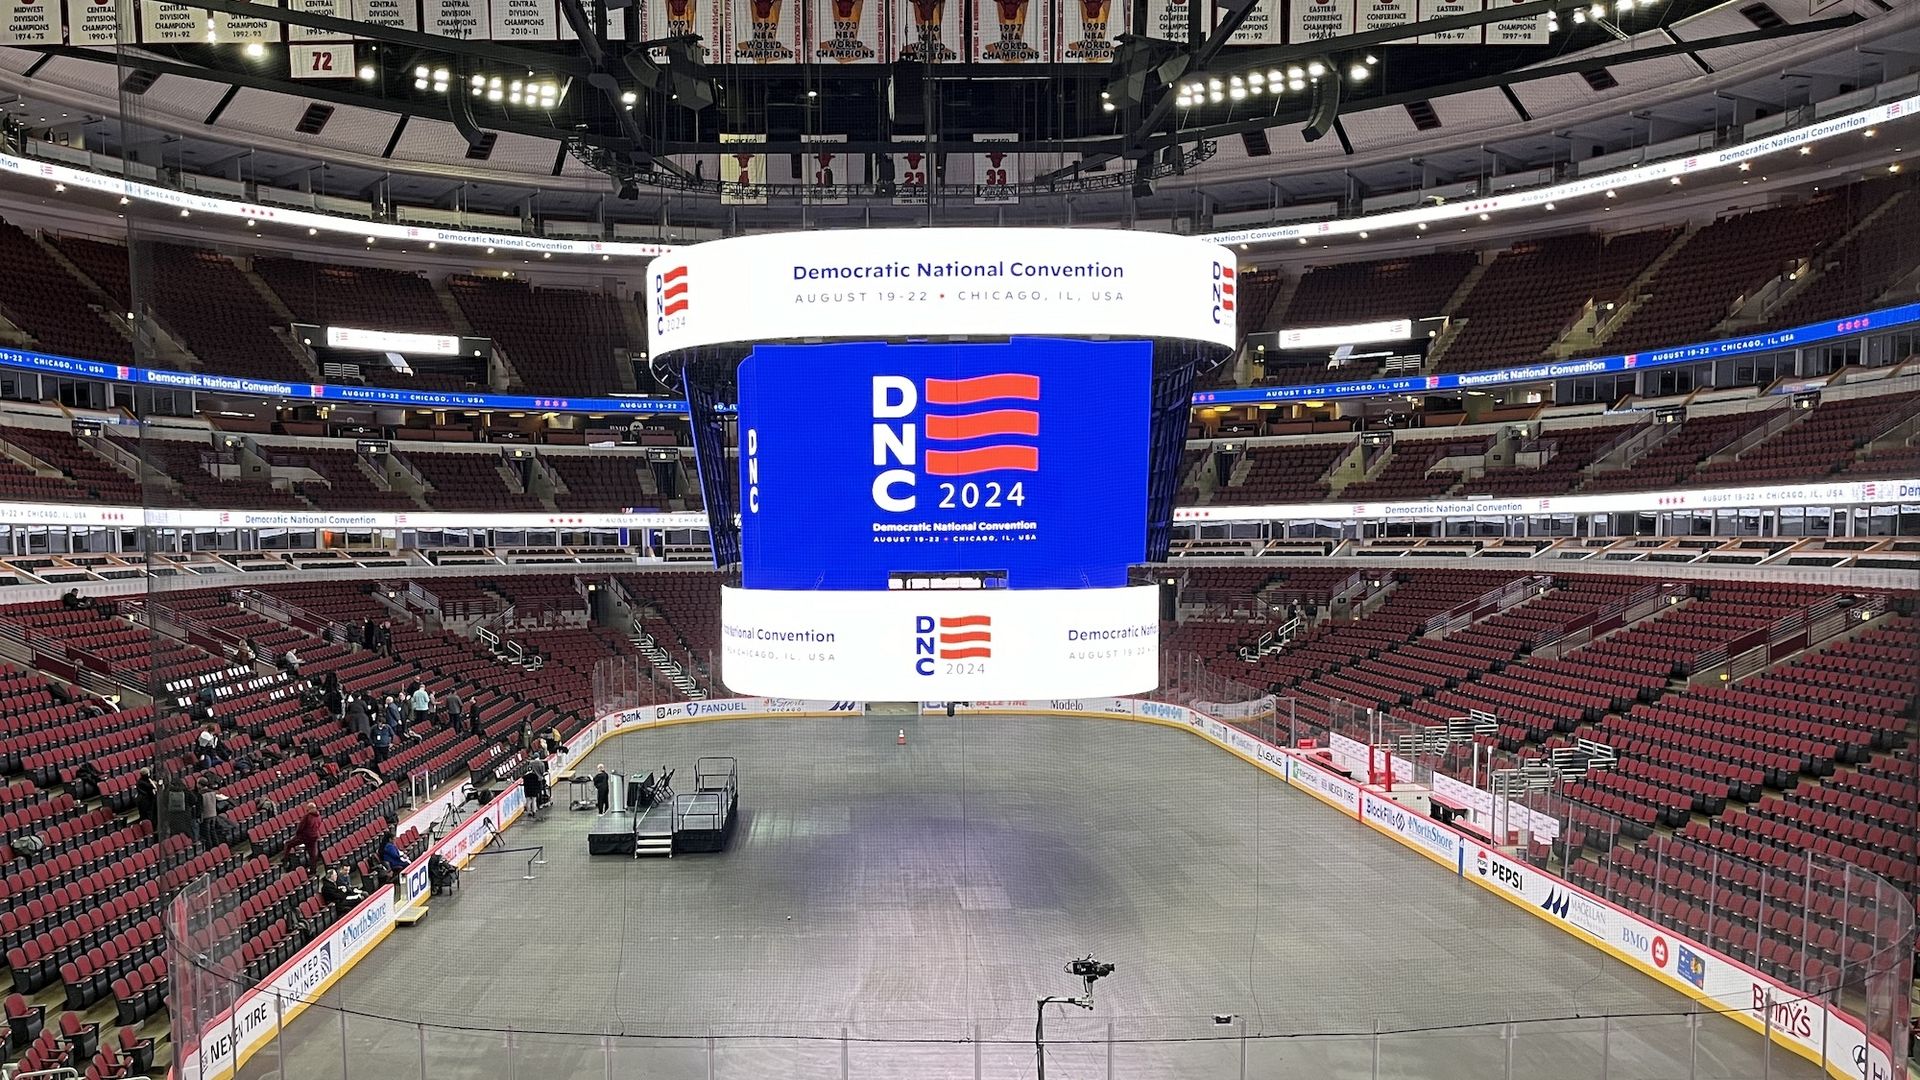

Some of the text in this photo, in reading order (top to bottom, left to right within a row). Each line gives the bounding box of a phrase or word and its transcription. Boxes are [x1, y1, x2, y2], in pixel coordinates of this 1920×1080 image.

[752, 22, 776, 30] 1992
[834, 22, 857, 30] 1993
[999, 23, 1022, 31] 1997
[1082, 22, 1106, 30] 1998
[754, 32, 774, 40] NBA
[1000, 32, 1020, 40] NBA
[1084, 32, 1104, 40] NBA
[746, 41, 781, 50] WORLD
[829, 40, 863, 49] WORLD
[994, 42, 1028, 50] WORLD
[1076, 40, 1110, 49] WORLD
[312, 52, 332, 70] 72
[735, 50, 794, 59] CHAMPIONS
[816, 50, 875, 58] CHAMPIONS
[982, 51, 1040, 60] CHAMPIONS
[1719, 116, 1866, 162] Democratic National Convention
[904, 172, 925, 185] 23
[986, 169, 1006, 186] 33
[438, 232, 573, 254] Democratic National Convention
[1213, 233, 1249, 244] National
[1250, 228, 1300, 240] Convention
[794, 261, 1124, 280] Democratic National Convention
[795, 292, 867, 304] AUGUST
[879, 292, 928, 302] 19-22
[958, 291, 1048, 302] CHICAGO,
[1092, 292, 1124, 301] USA
[1212, 260, 1221, 324] DNC
[656, 274, 664, 336] DNC
[1652, 351, 1685, 361] AUGUST
[1687, 348, 1710, 356] 19-22
[1721, 340, 1764, 352] CHICAGO,
[1780, 334, 1794, 342] USA
[34, 357, 73, 370] CHICAGO,
[89, 366, 105, 374] USA
[1458, 361, 1606, 385] Democratic National Convention
[147, 372, 292, 395] Democratic National Convention
[1266, 390, 1300, 398] AUGUST
[1303, 388, 1326, 396] 19-22
[1335, 384, 1376, 394] CHICAGO,
[342, 390, 374, 398] AUGUST
[378, 392, 400, 400] 19-22
[410, 394, 450, 404] CHICAGO,
[872, 376, 918, 512] DNC
[748, 429, 759, 514] DNC
[938, 482, 1026, 508] 2024
[1385, 502, 1523, 514] Democratic National Convention
[246, 515, 376, 525] Democratic National Convention
[872, 520, 1037, 532] Democratic National Convention
[953, 535, 998, 543] CHICAGO,
[756, 628, 834, 642] Convention
[1068, 625, 1138, 641] Democratic
[915, 616, 936, 676] DNC
[808, 653, 834, 661] USA
[1069, 650, 1118, 660] AUGUST
[946, 663, 985, 675] 2024
[701, 702, 748, 713] FANDUEL
[1050, 700, 1084, 712] Modelo
[1263, 751, 1282, 768] LEXUS
[1328, 782, 1354, 804] NEXEN TIRE
[1366, 798, 1396, 826] BlockFills
[1411, 818, 1454, 850] NorthShore
[1492, 860, 1523, 890] PEPSI
[1570, 898, 1606, 926] MAGELLAN
[346, 902, 386, 940] NorthShore
[1622, 928, 1648, 952] BMO
[287, 955, 318, 987] UNITED
[281, 970, 319, 1009] AIRLINES
[210, 1002, 268, 1063] NEXEN TIRE
